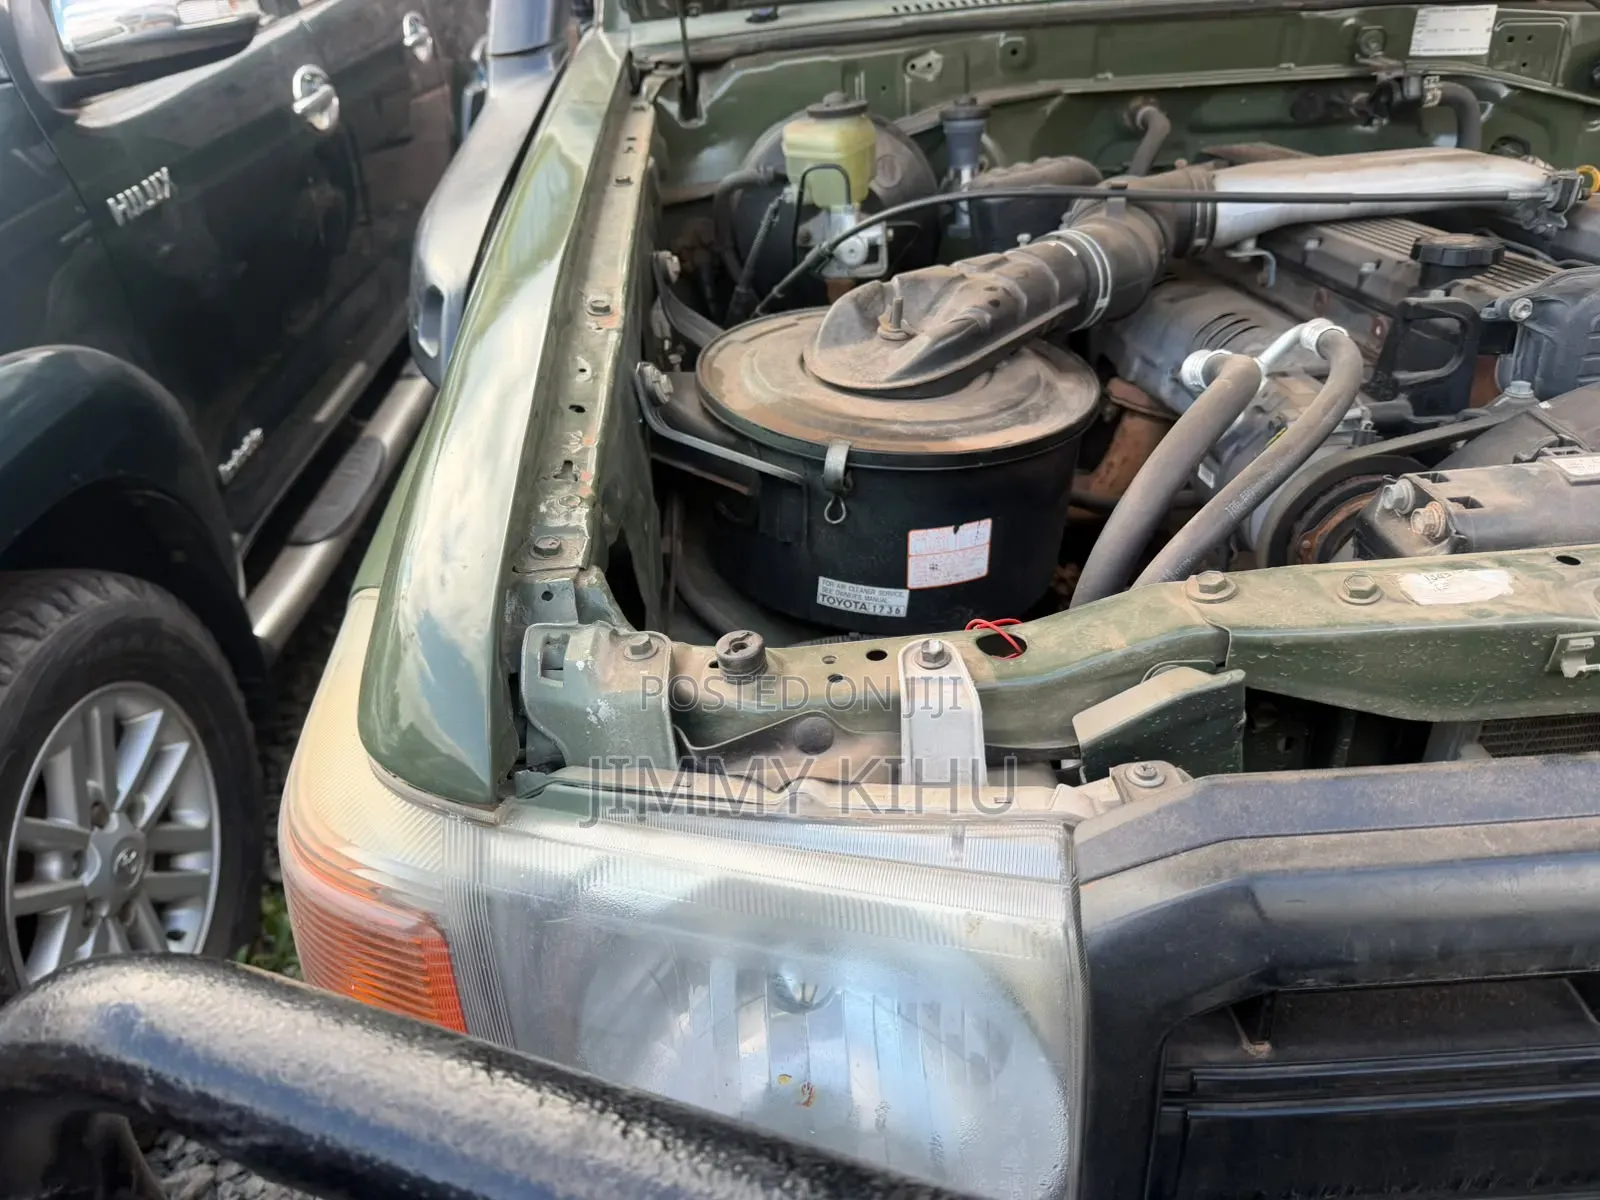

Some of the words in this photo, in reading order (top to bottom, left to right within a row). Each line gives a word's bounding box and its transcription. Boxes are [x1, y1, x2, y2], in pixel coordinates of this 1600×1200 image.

[106, 166, 176, 226] HILUX
[848, 585, 876, 595] CLEANER
[820, 594, 867, 611] TOYOTA
